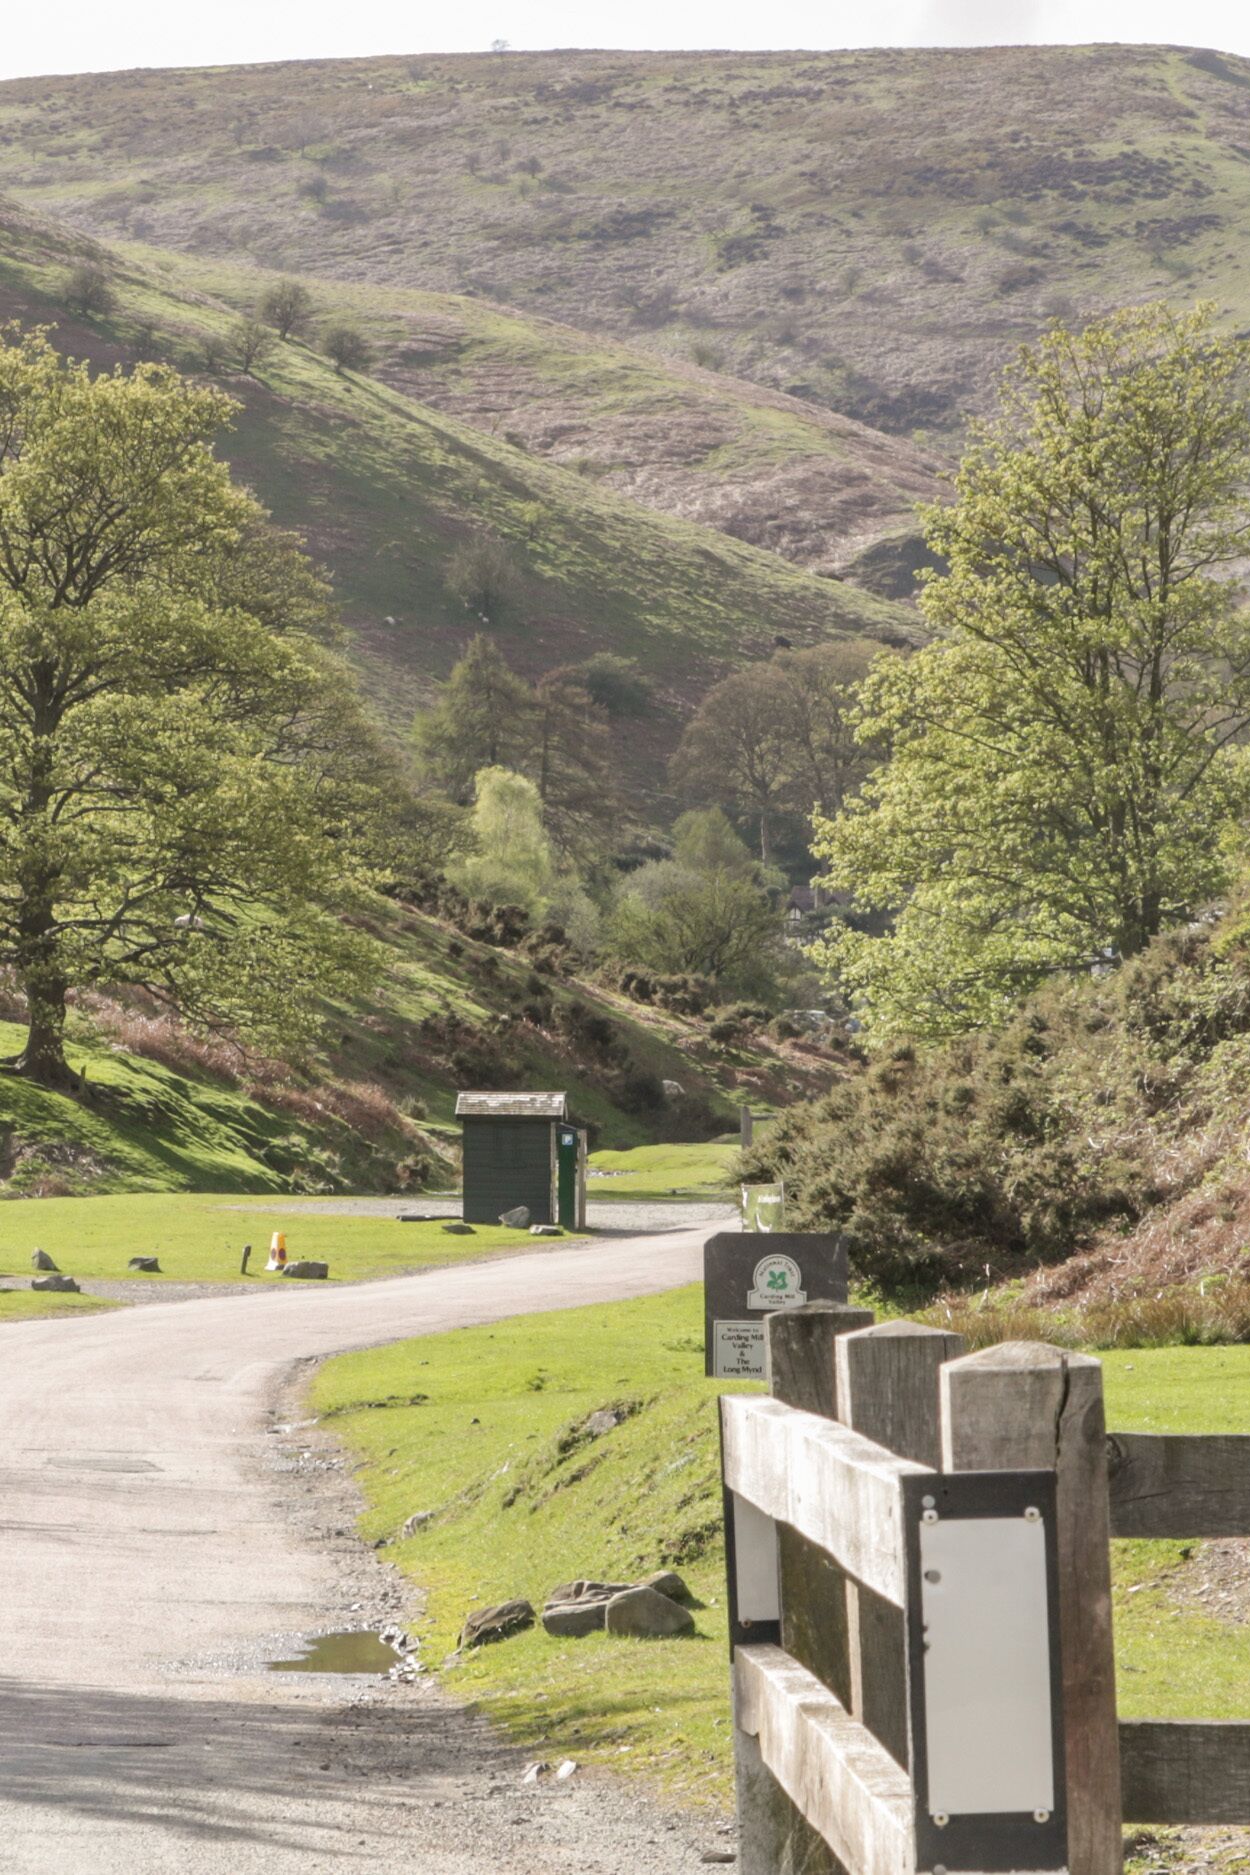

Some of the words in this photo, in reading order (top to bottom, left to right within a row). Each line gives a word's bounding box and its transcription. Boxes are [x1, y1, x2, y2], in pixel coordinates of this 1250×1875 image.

[721, 1334, 749, 1342] Carding
[732, 1342, 753, 1350] Valley
[723, 1365, 741, 1374] Long
[742, 1366, 763, 1374] Mynd
